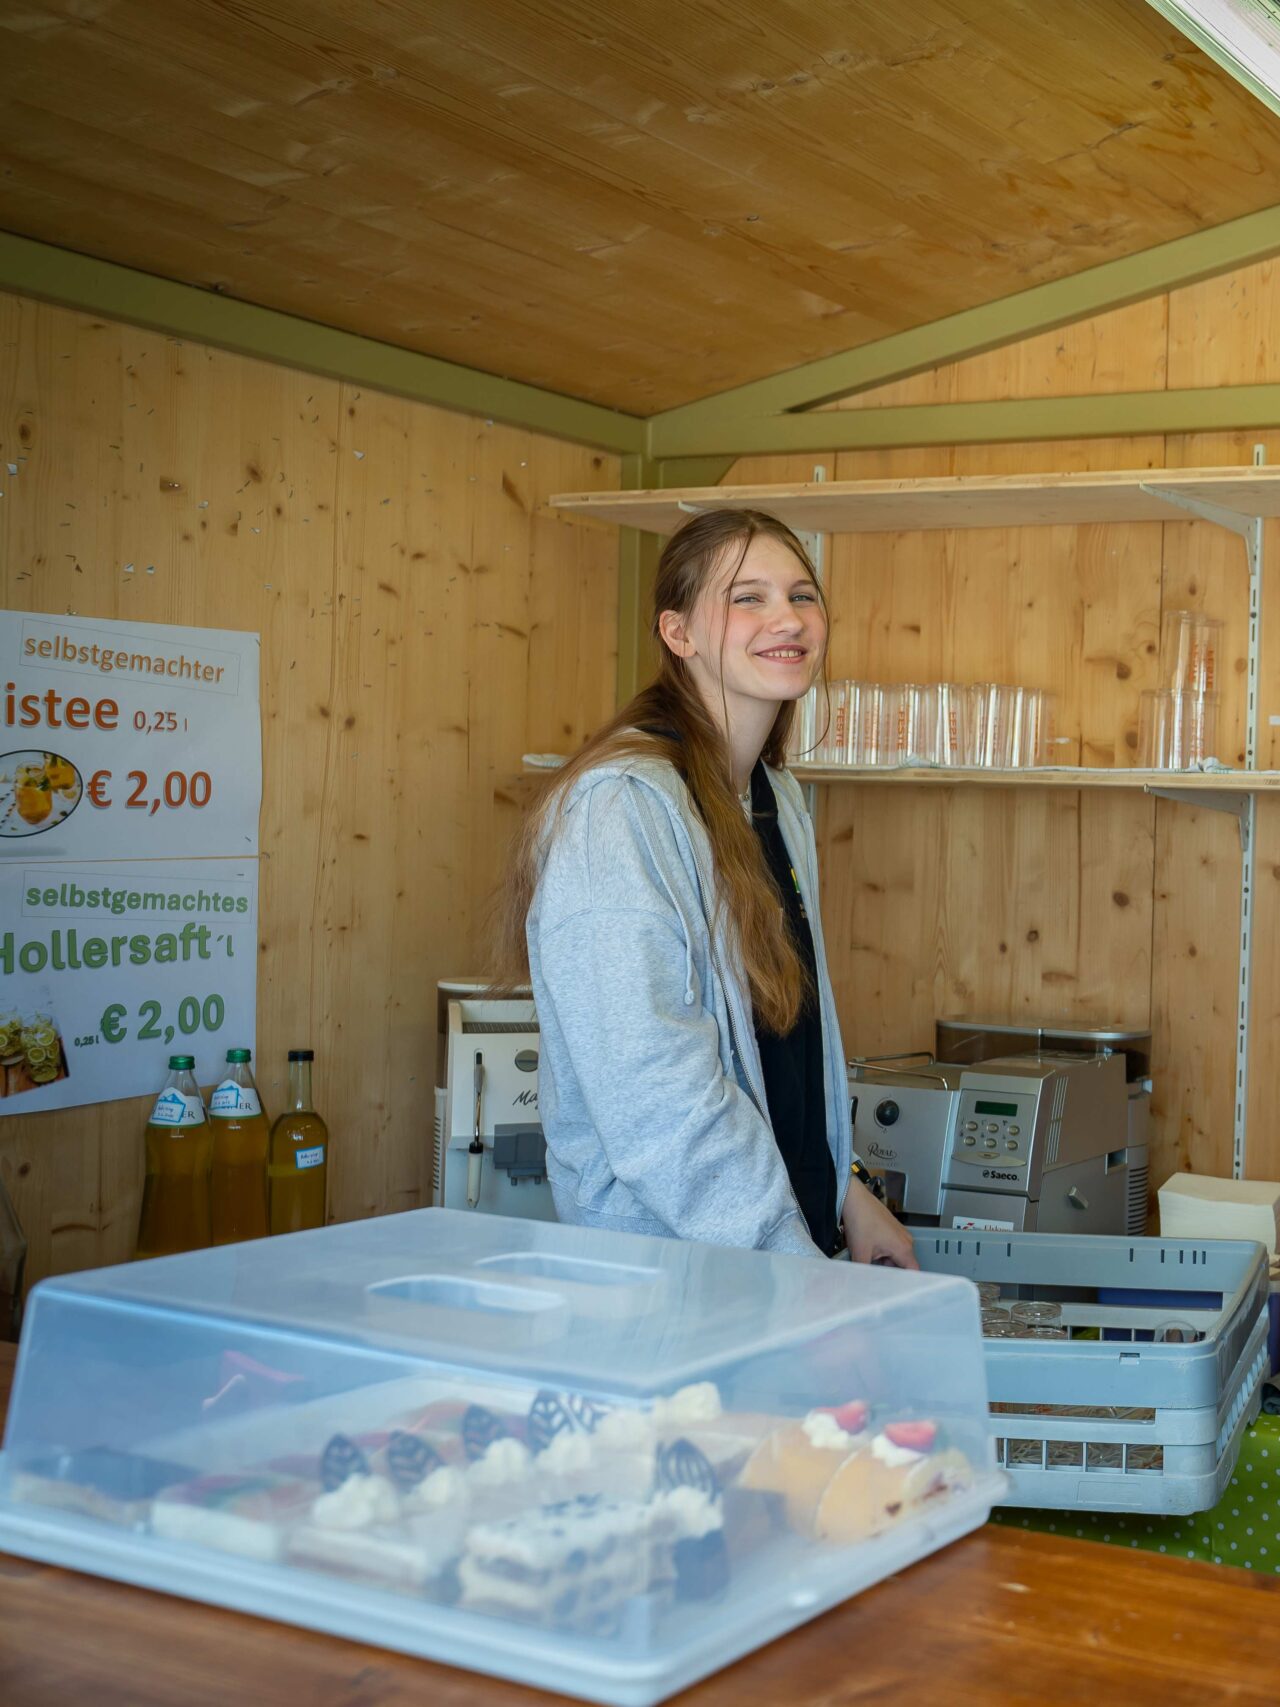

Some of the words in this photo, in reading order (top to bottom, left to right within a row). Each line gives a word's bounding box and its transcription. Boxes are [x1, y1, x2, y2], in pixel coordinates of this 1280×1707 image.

[24, 636, 225, 683] selbstgemachter
[5, 682, 119, 729] istee
[133, 710, 178, 735] 0,25
[835, 707, 845, 748] FESTE
[88, 770, 113, 808] €
[126, 770, 213, 817] 2,00
[26, 884, 249, 915] selbstgemachtes
[74, 1035, 94, 1048] 0,25
[100, 1003, 127, 1044] €
[137, 993, 225, 1045] 2,00
[991, 1170, 1018, 1182] Saeco
